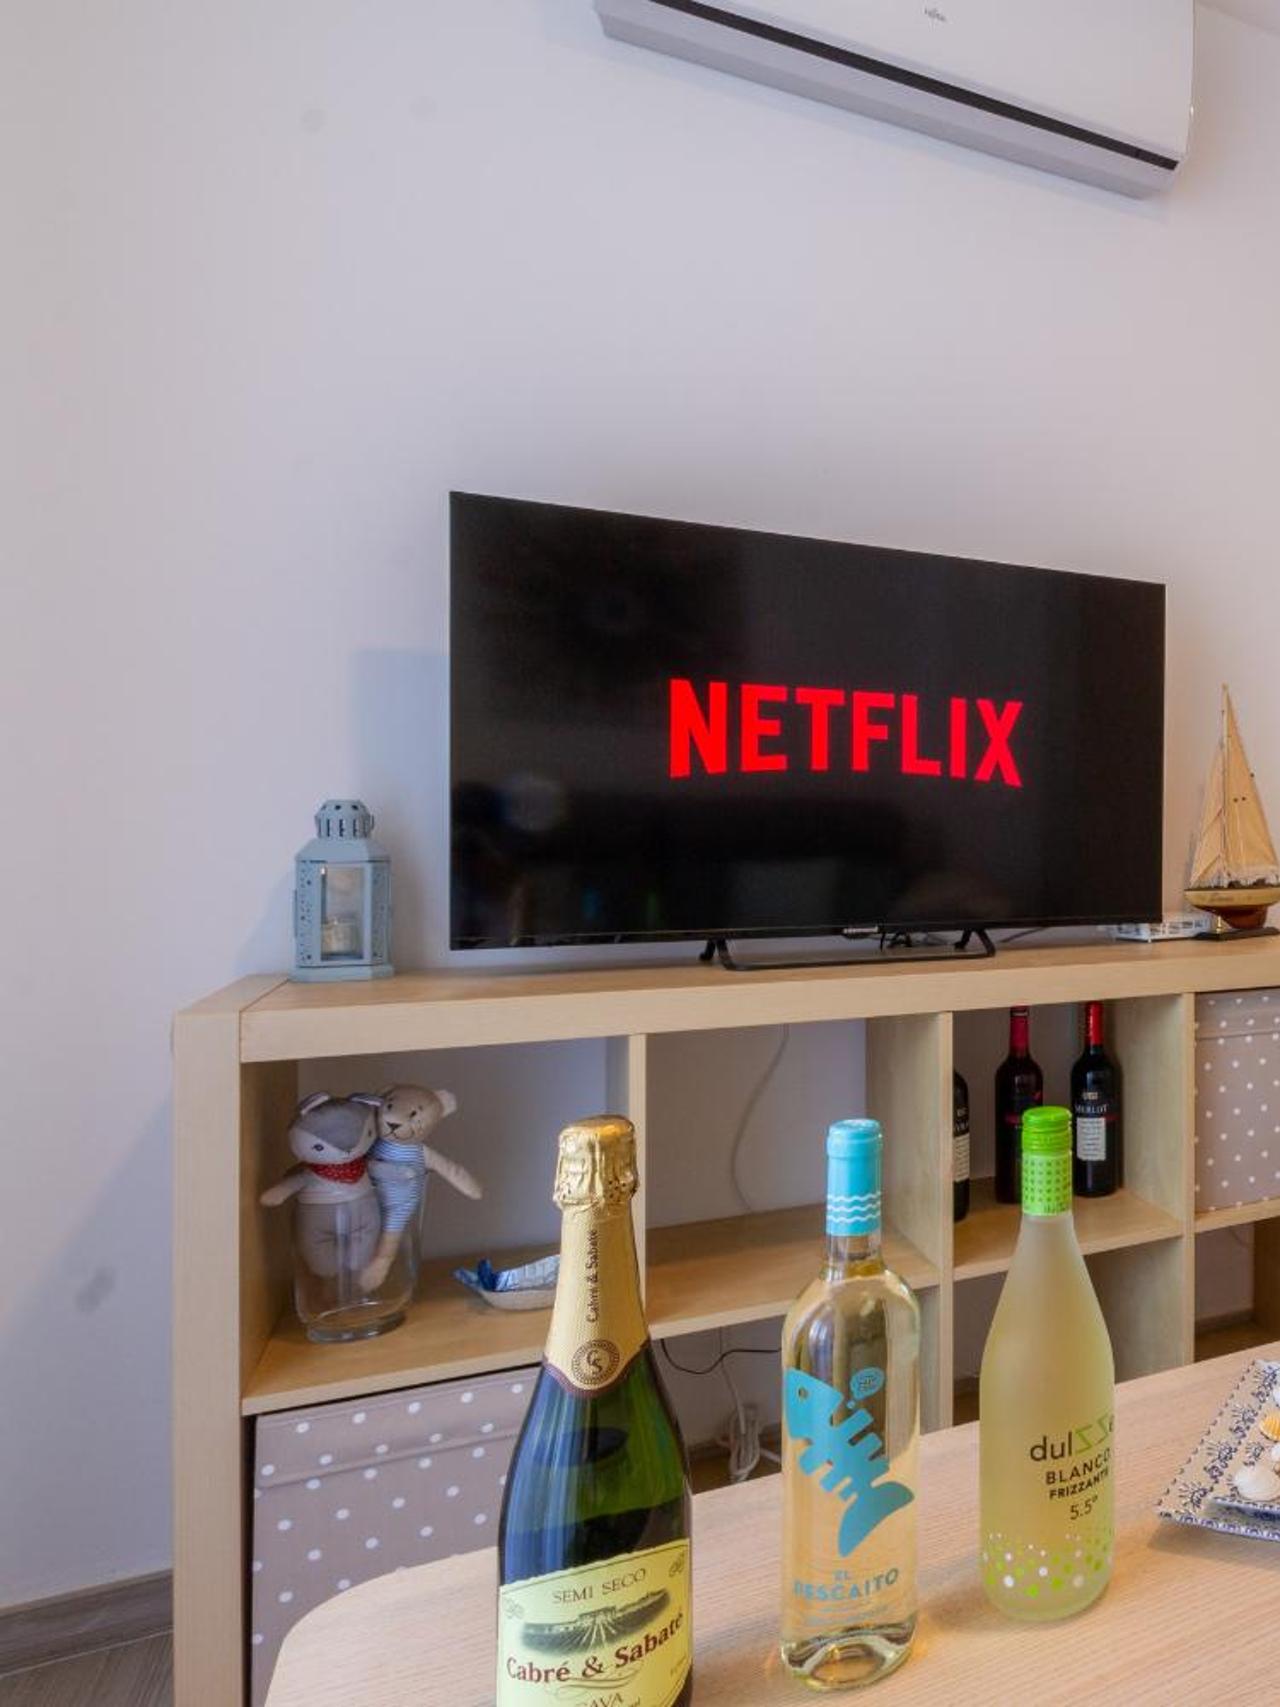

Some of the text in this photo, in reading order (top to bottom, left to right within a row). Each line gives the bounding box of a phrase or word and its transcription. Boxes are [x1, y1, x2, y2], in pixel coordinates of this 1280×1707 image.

[670, 679, 1023, 788] NETFLIX
[1046, 1447, 1110, 1485] BLANCO
[552, 1568, 646, 1604] SEMI SECO
[506, 1656, 570, 1683] Cabré
[581, 1655, 605, 1678] &
